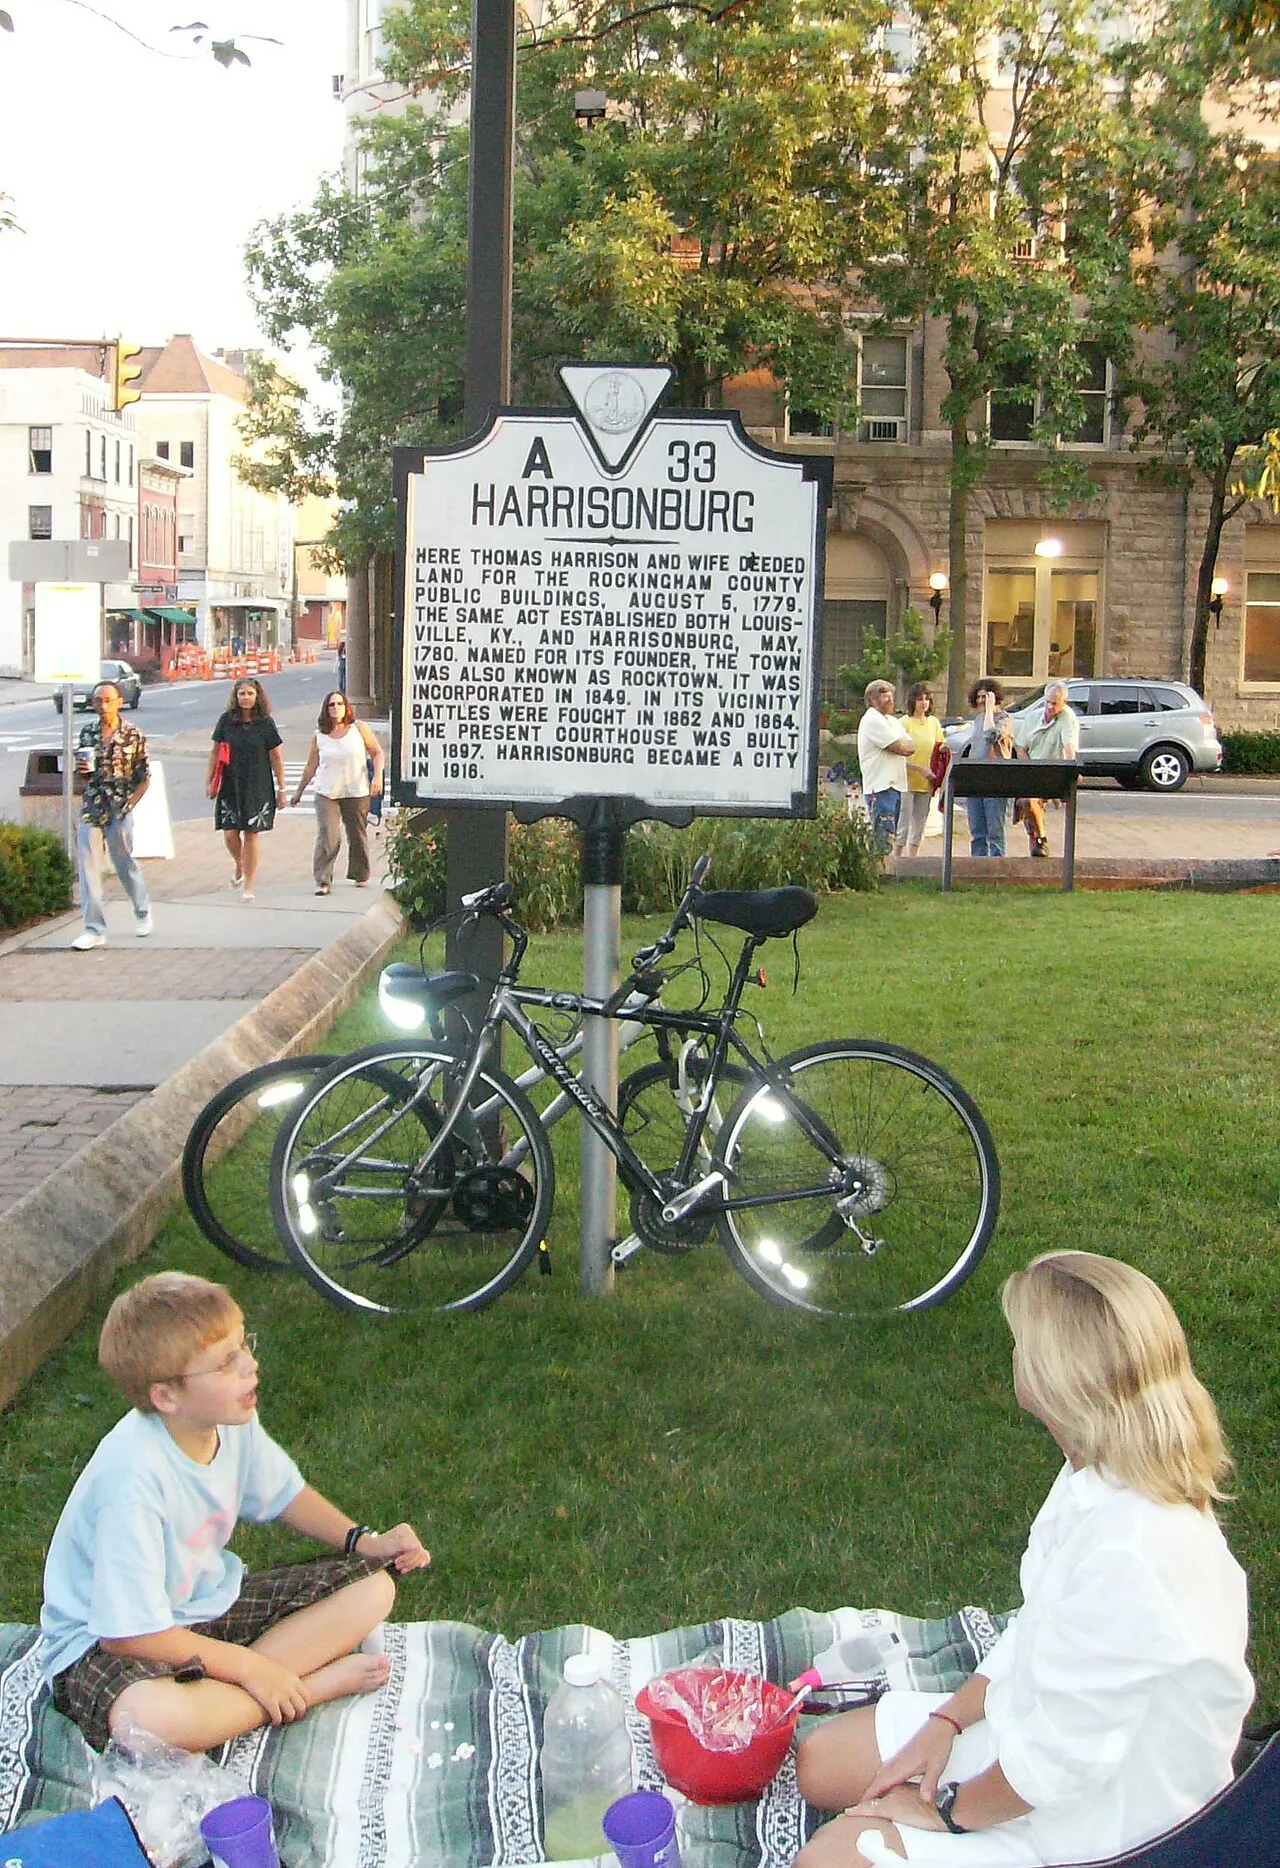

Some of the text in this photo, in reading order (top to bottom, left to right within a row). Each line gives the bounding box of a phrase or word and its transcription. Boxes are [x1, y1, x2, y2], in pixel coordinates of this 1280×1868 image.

[522, 437, 715, 482] A 33
[472, 484, 755, 533] HARRISONBURG
[416, 548, 461, 564] HERE
[470, 549, 542, 566] THOMAS
[551, 551, 638, 569] HARRISON
[647, 554, 681, 570] AND
[688, 555, 729, 571] WIFE
[416, 567, 804, 593] LAND FOR THE ROCKINGHAM COUNTY
[415, 587, 802, 613] PUBLIC BUILDINGS, AUGUST 5, 1779.
[415, 606, 803, 632] THE SAME ACT ESTABLISHED BOTH LOUIS-
[415, 625, 802, 654] VILLE, KY., AND HARRISONBURG, MAY,
[415, 646, 801, 671] 1780. NAMED FOR ITS FOUNDER, THE TOWN
[414, 665, 800, 691] WAS ALSO KNOWN AS ROCKTOWN. IT WAS
[413, 684, 800, 711] INCORPORATED IN 1849. IN ITS VICINITY
[412, 704, 799, 730] BATTLES WERE FOUGHT IN 1862 AND 1864.
[413, 722, 799, 750] THE PRESENT COURTHOUSE WAS BUILT
[412, 742, 799, 769] IN 1897. HARRISONBURG BECAME A CITY
[412, 762, 484, 779] IN 1916.
